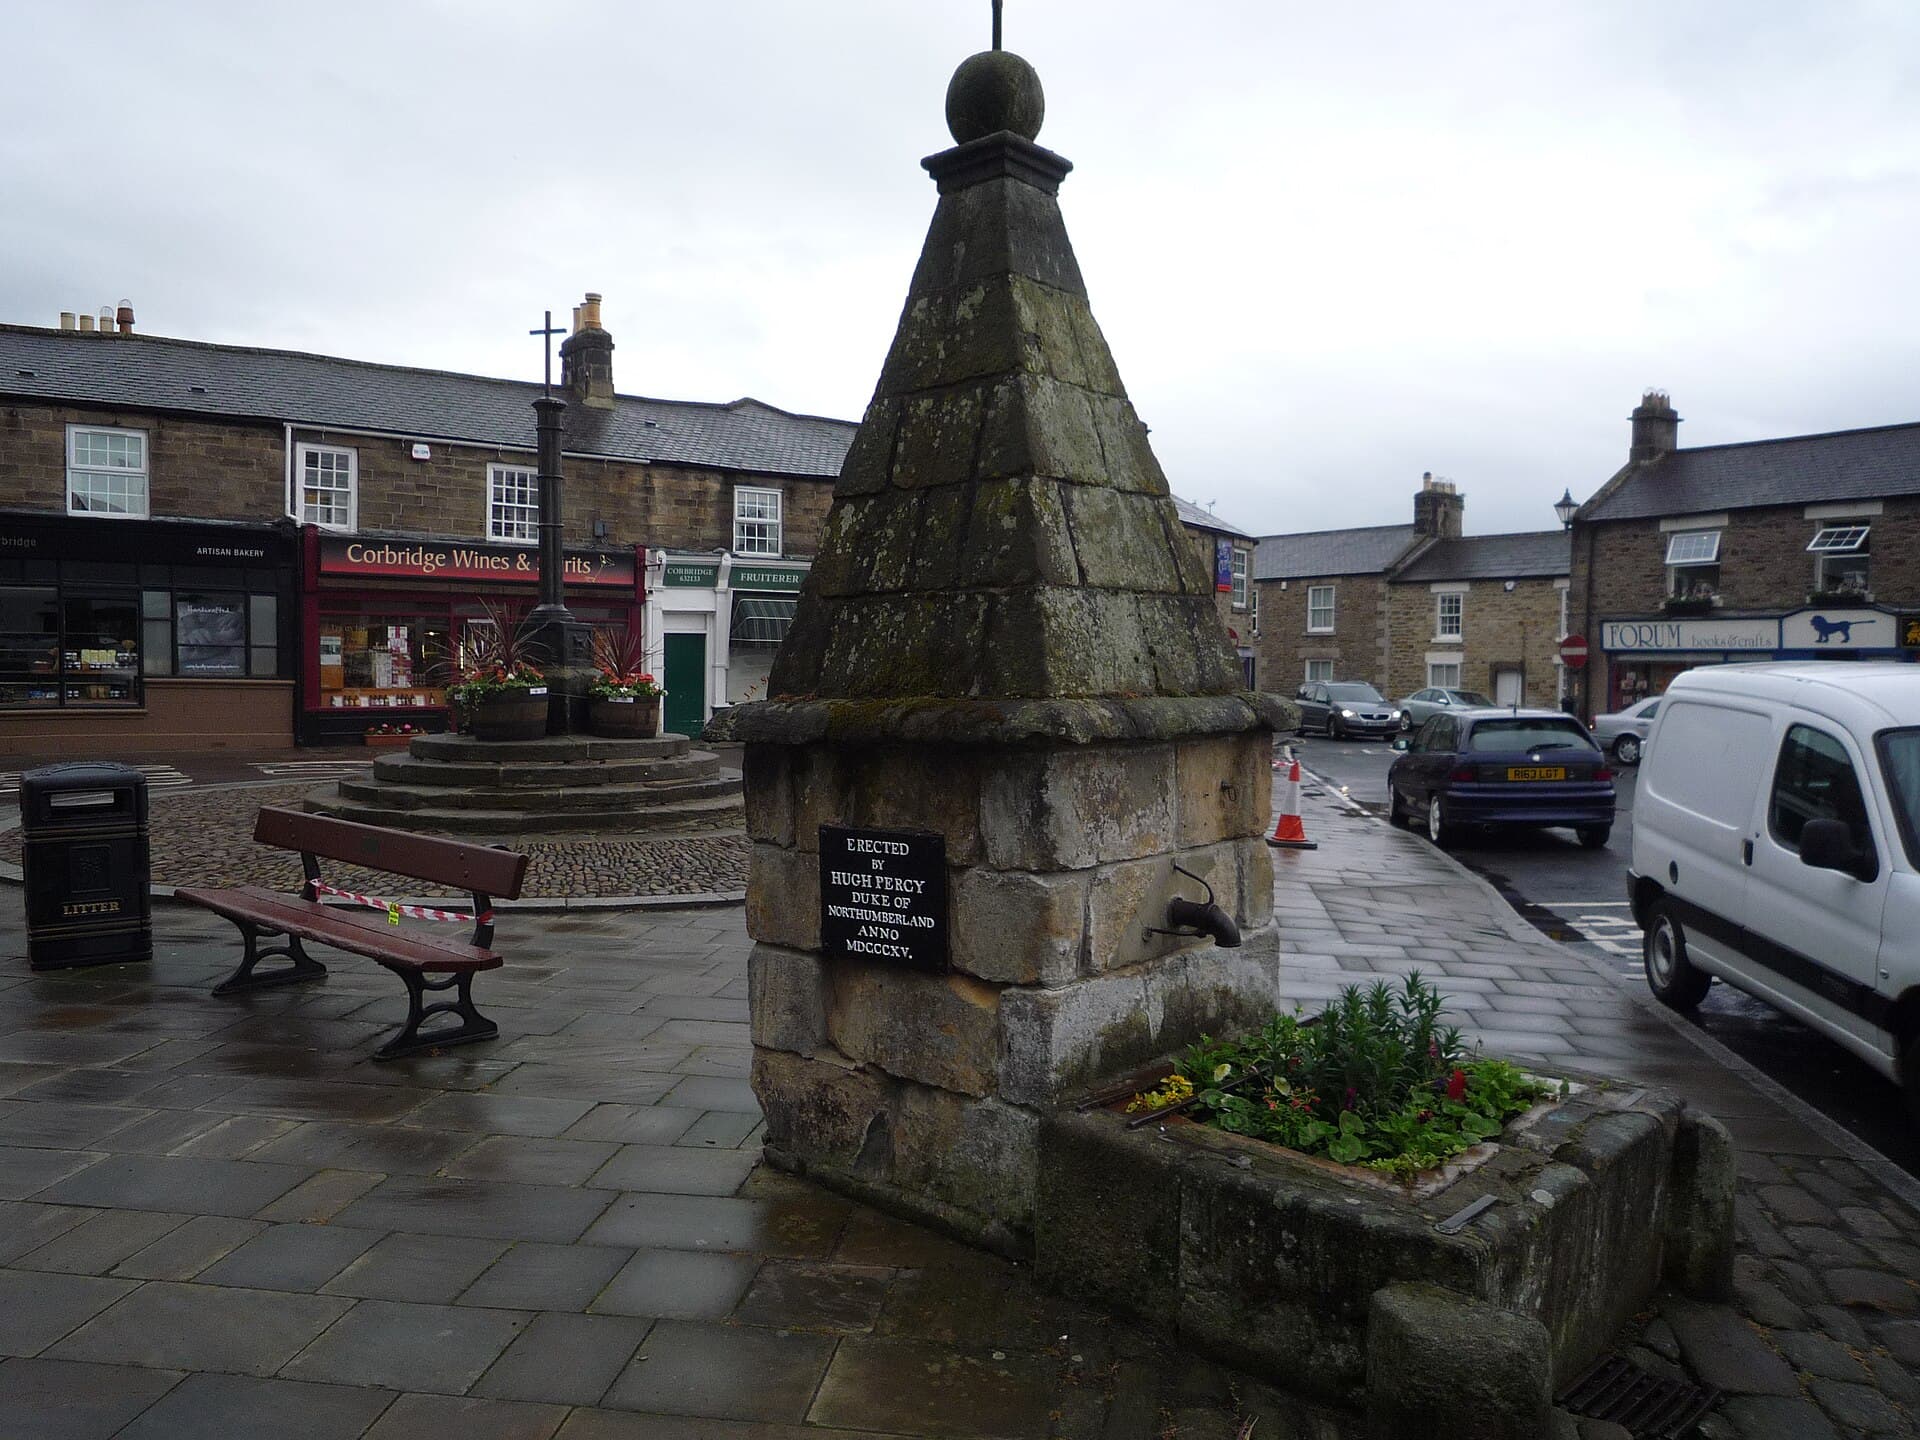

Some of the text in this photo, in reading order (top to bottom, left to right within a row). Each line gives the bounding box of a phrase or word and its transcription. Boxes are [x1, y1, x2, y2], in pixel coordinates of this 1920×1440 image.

[0, 535, 37, 548] bridge
[196, 547, 265, 558] ARTISAN BAKERY
[347, 543, 591, 574] Corbridge Wines & rits
[667, 567, 713, 576] CORBRIDGE
[740, 572, 799, 583] FRUITERER
[1609, 624, 1681, 648] FORUM
[846, 838, 910, 856] ERECTED
[871, 859, 885, 870] BY
[831, 871, 926, 894] HUGH PERCY
[851, 891, 911, 909] DUKE OF
[63, 901, 120, 915] LITTER
[827, 904, 935, 929] NORTHUMBERLAND
[857, 925, 900, 940] ANNO
